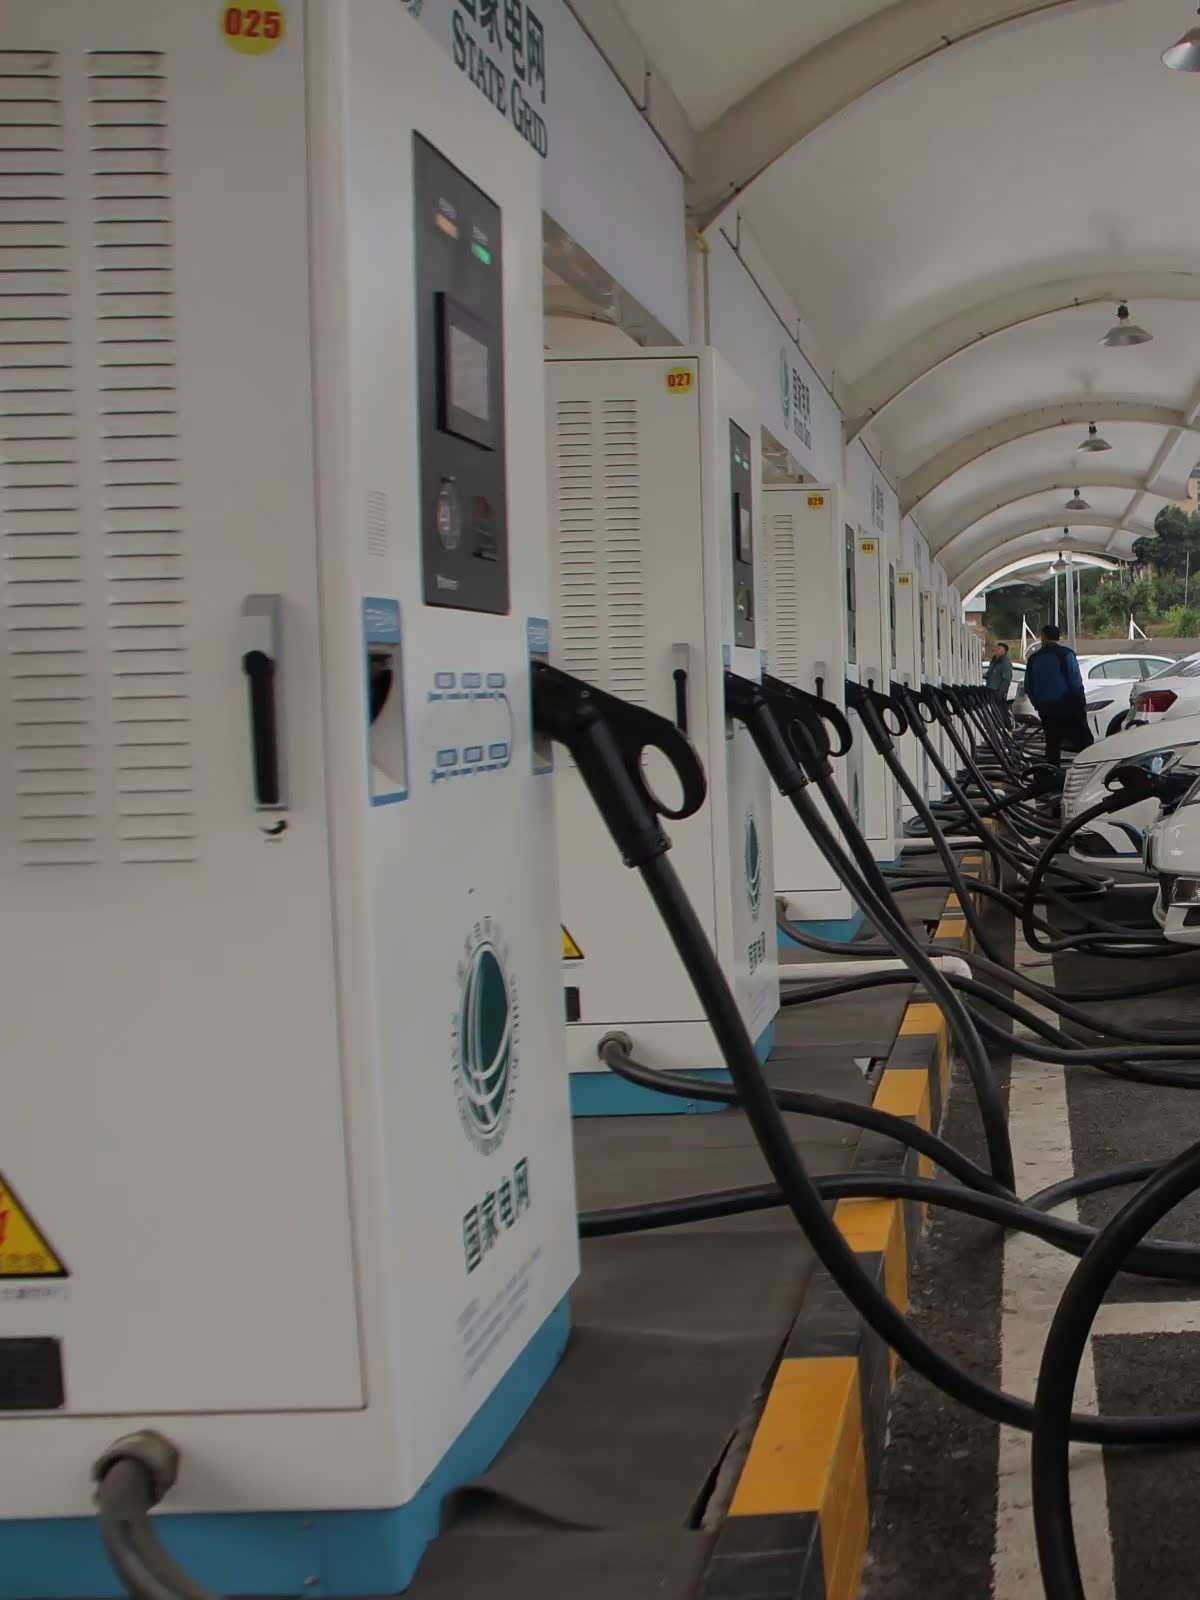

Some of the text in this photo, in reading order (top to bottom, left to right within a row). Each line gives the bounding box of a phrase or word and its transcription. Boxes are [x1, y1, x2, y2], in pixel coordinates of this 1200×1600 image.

[224, 8, 281, 38] 025
[453, 9, 548, 159] STATE GRID
[668, 372, 690, 387] 027
[463, 1156, 530, 1275] 国家电网
